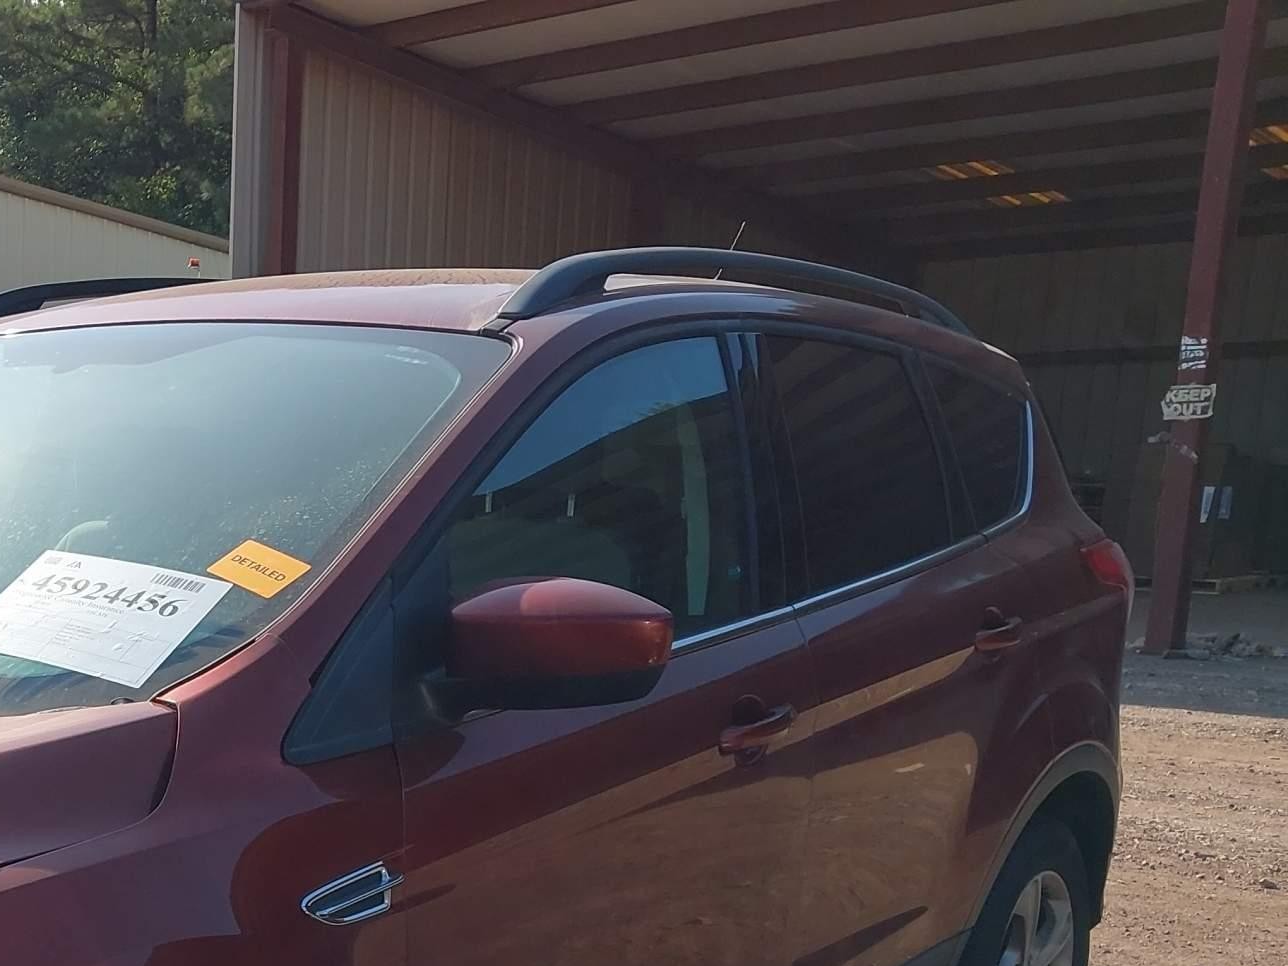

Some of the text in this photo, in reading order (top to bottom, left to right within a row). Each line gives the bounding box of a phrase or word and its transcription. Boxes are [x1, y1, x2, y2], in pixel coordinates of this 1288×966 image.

[1166, 388, 1212, 403] KEEP
[1172, 402, 1209, 416] OUT
[231, 554, 287, 582] DETAILED
[31, 574, 188, 617] 45924456
